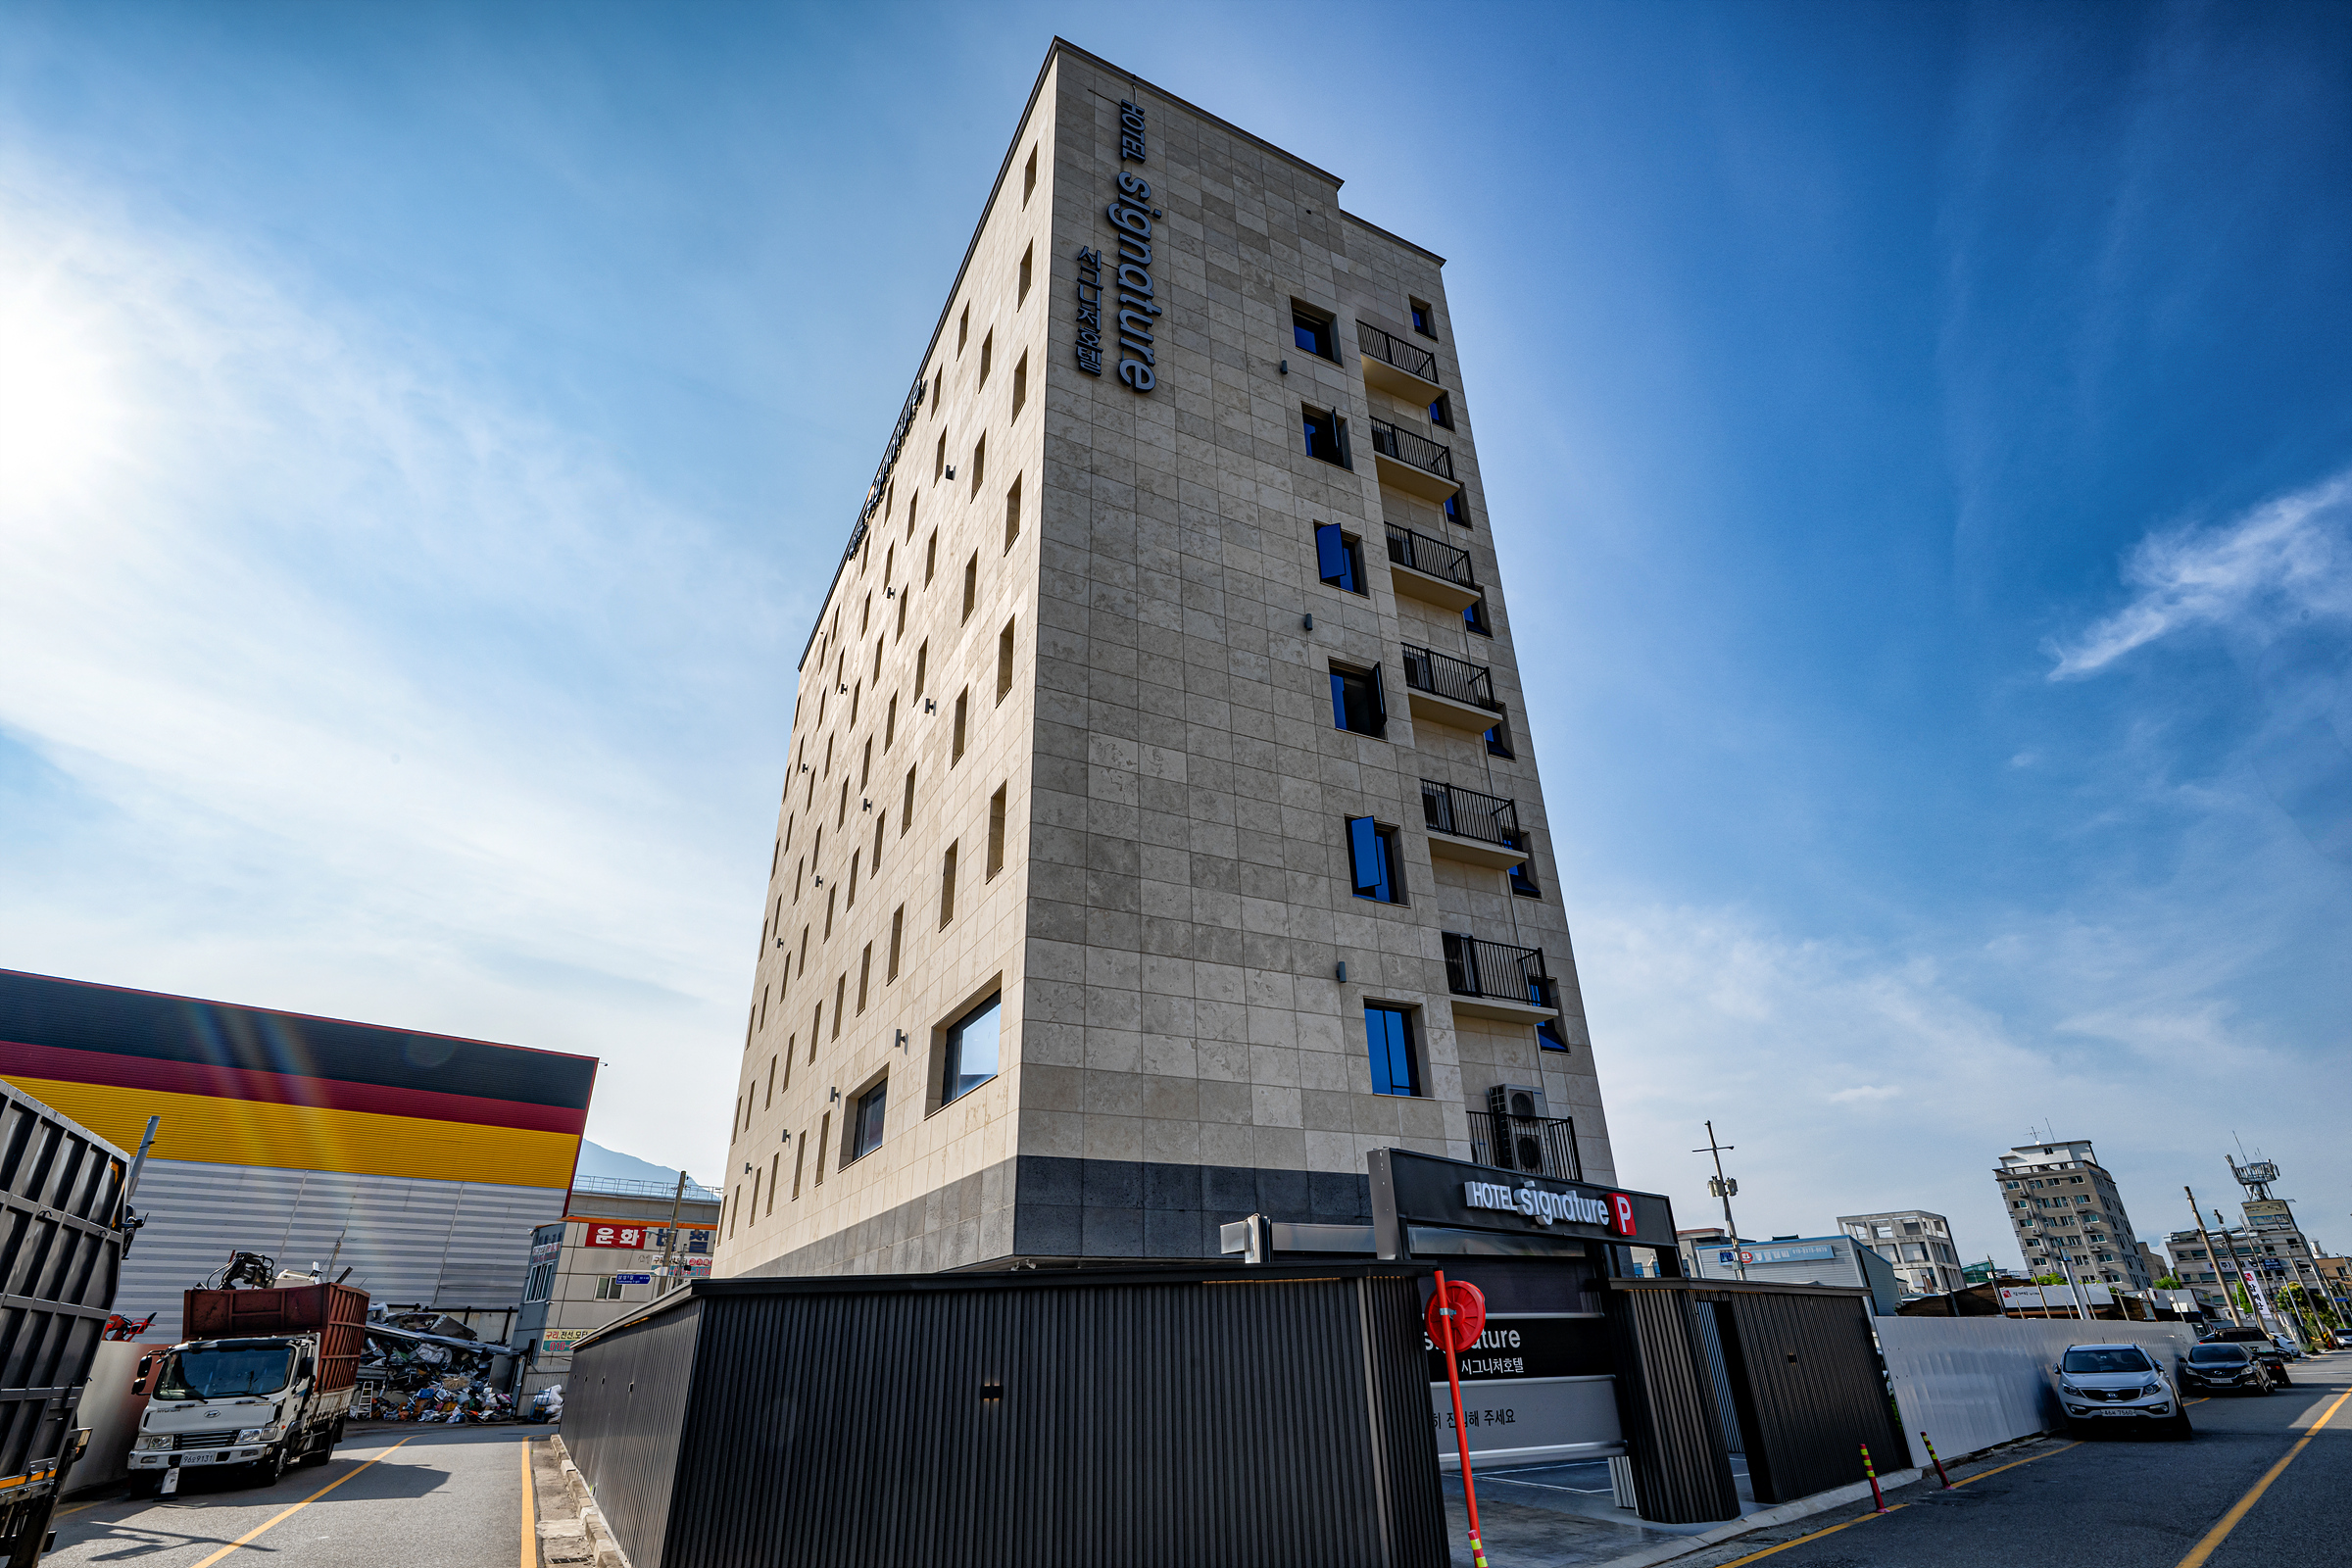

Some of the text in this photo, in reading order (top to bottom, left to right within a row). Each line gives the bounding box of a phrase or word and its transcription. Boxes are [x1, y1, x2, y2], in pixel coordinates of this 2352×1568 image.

[1106, 98, 1162, 393] HOTEL signature
[1076, 245, 1103, 377] 시그니처호텔
[1465, 1180, 1632, 1233] HOTEL signature P
[1424, 1329, 1521, 1354] sture
[1461, 1357, 1524, 1375] 시그니처호텔
[1484, 1408, 1515, 1427] 주세요
